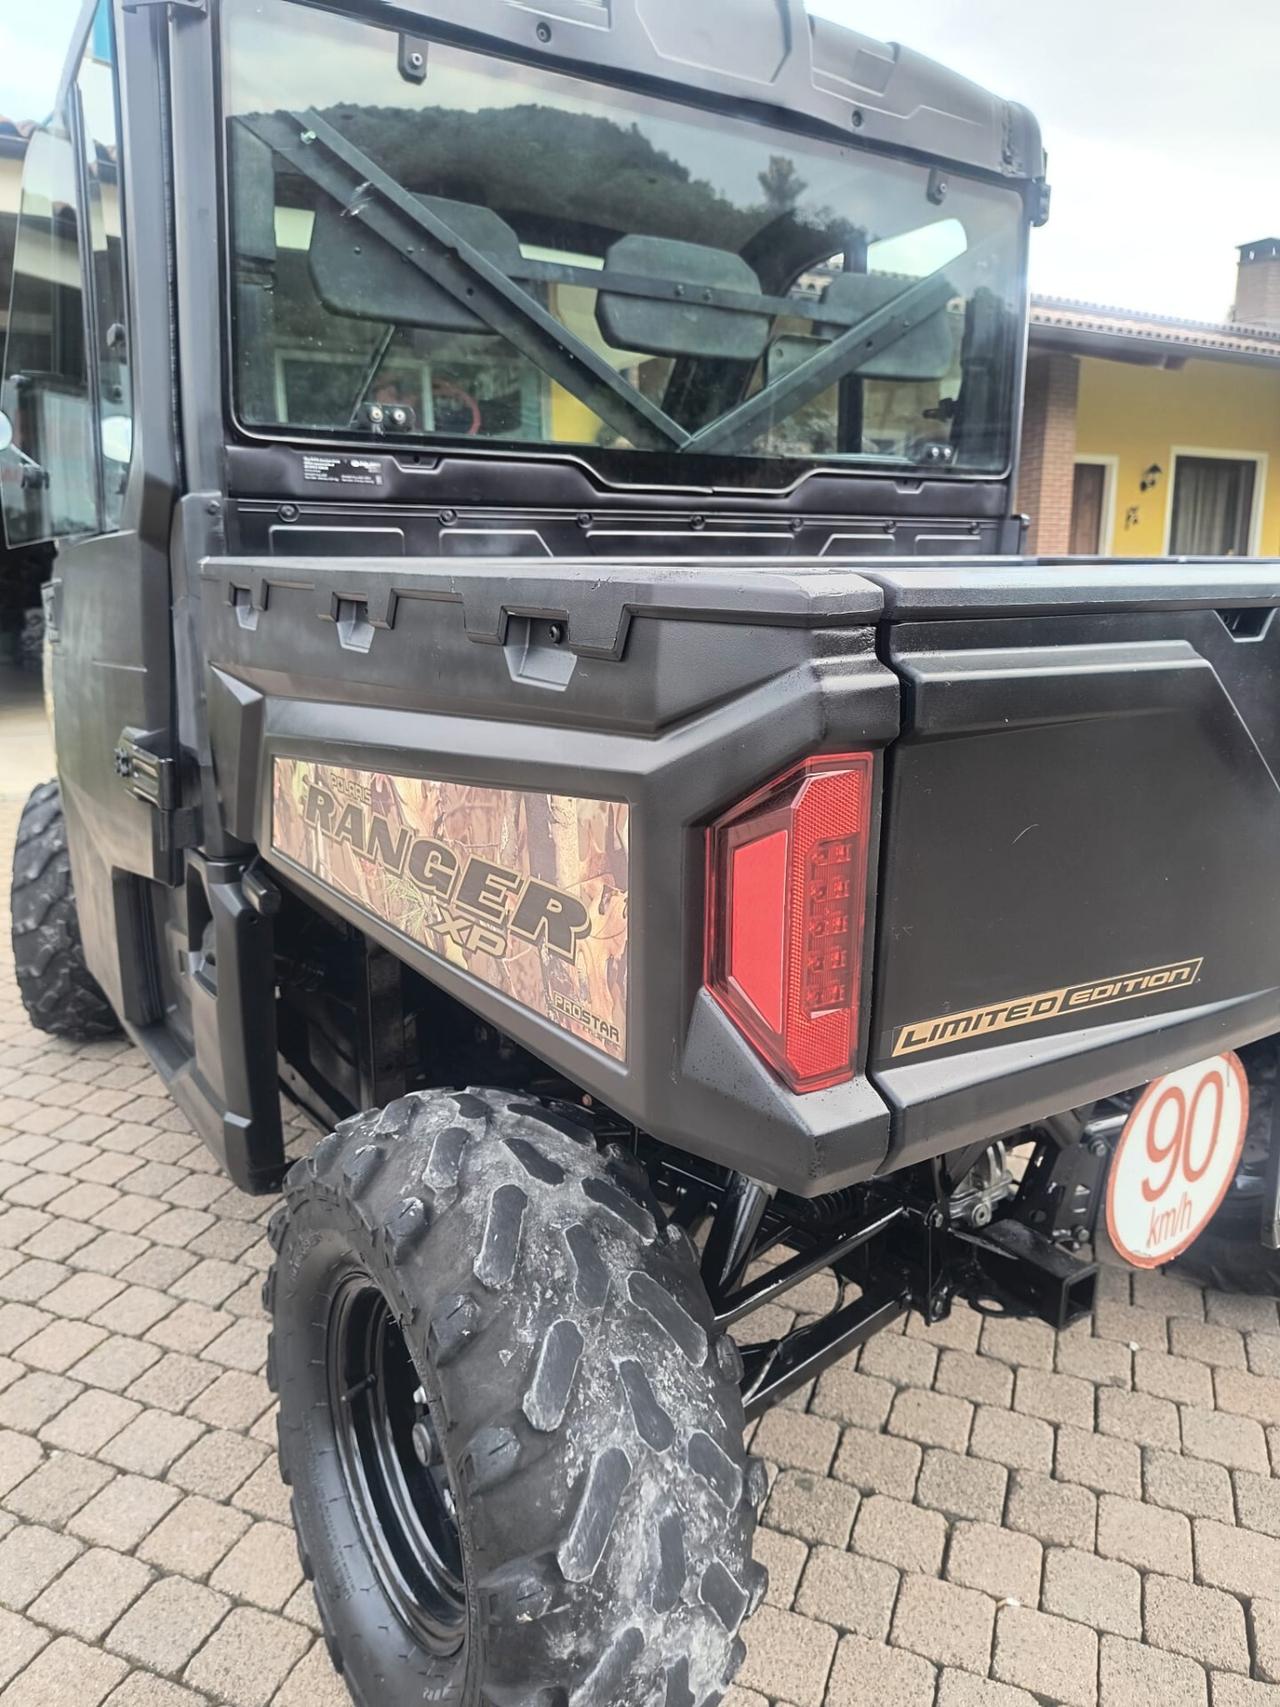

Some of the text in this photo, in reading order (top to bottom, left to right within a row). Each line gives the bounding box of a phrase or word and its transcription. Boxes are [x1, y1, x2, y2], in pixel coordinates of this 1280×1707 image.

[330, 772, 372, 805] POLARIS
[304, 783, 591, 965] RANGER
[430, 911, 507, 958] XP
[555, 994, 620, 1043] PROSTAR
[902, 967, 1191, 1049] LIMITED EDITION
[1141, 1070, 1224, 1202] 90
[1146, 1191, 1193, 1249] km/h
